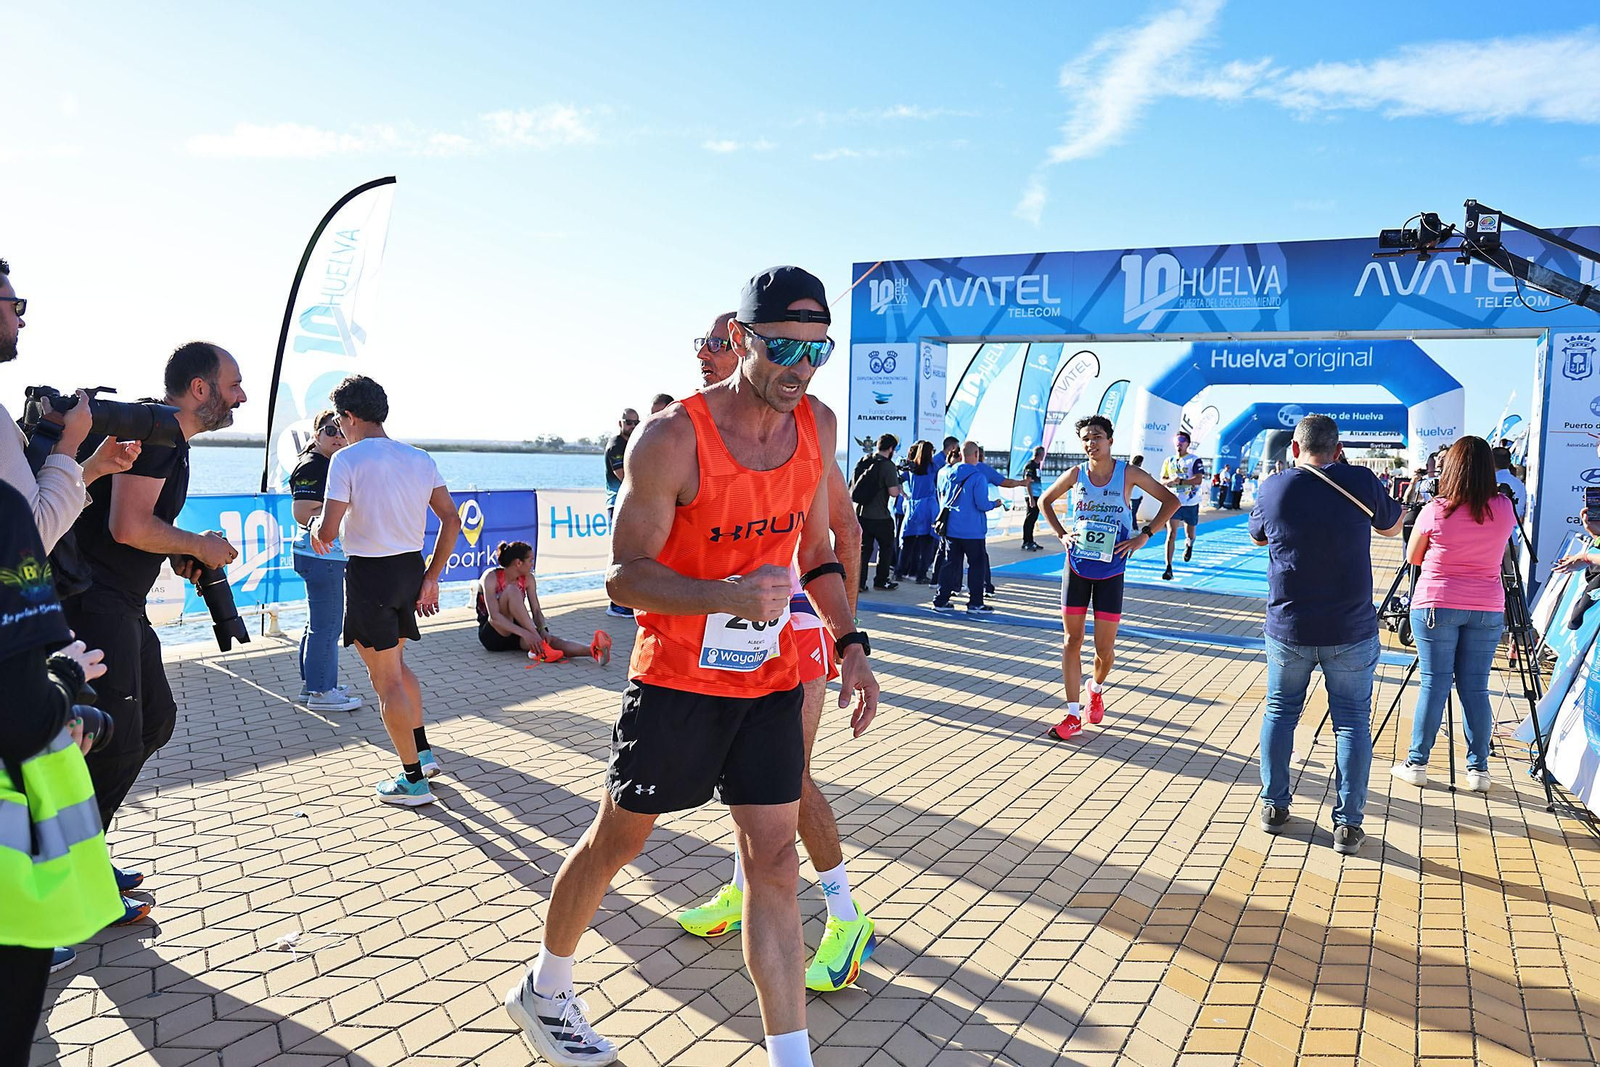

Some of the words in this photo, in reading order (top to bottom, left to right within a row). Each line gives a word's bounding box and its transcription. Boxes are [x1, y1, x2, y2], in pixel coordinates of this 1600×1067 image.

[318, 229, 360, 305] HUELVA
[1180, 265, 1282, 297] HUELVA
[922, 274, 1061, 308] AVATEL
[1179, 298, 1205, 308] PUERTA
[1206, 298, 1219, 308] DEL
[1220, 296, 1282, 308] DESCUBRIMIENTO
[1475, 295, 1550, 308] TELECOM
[1008, 307, 1061, 318] TELECOM
[1211, 348, 1287, 368] Huelva
[1294, 346, 1373, 371] original
[1339, 411, 1351, 420] de
[1353, 411, 1384, 420] Huelva
[1416, 426, 1454, 436] Huelva
[1564, 421, 1593, 429] Puerto
[1086, 530, 1106, 544] 62
[720, 651, 764, 665] Wayalio
